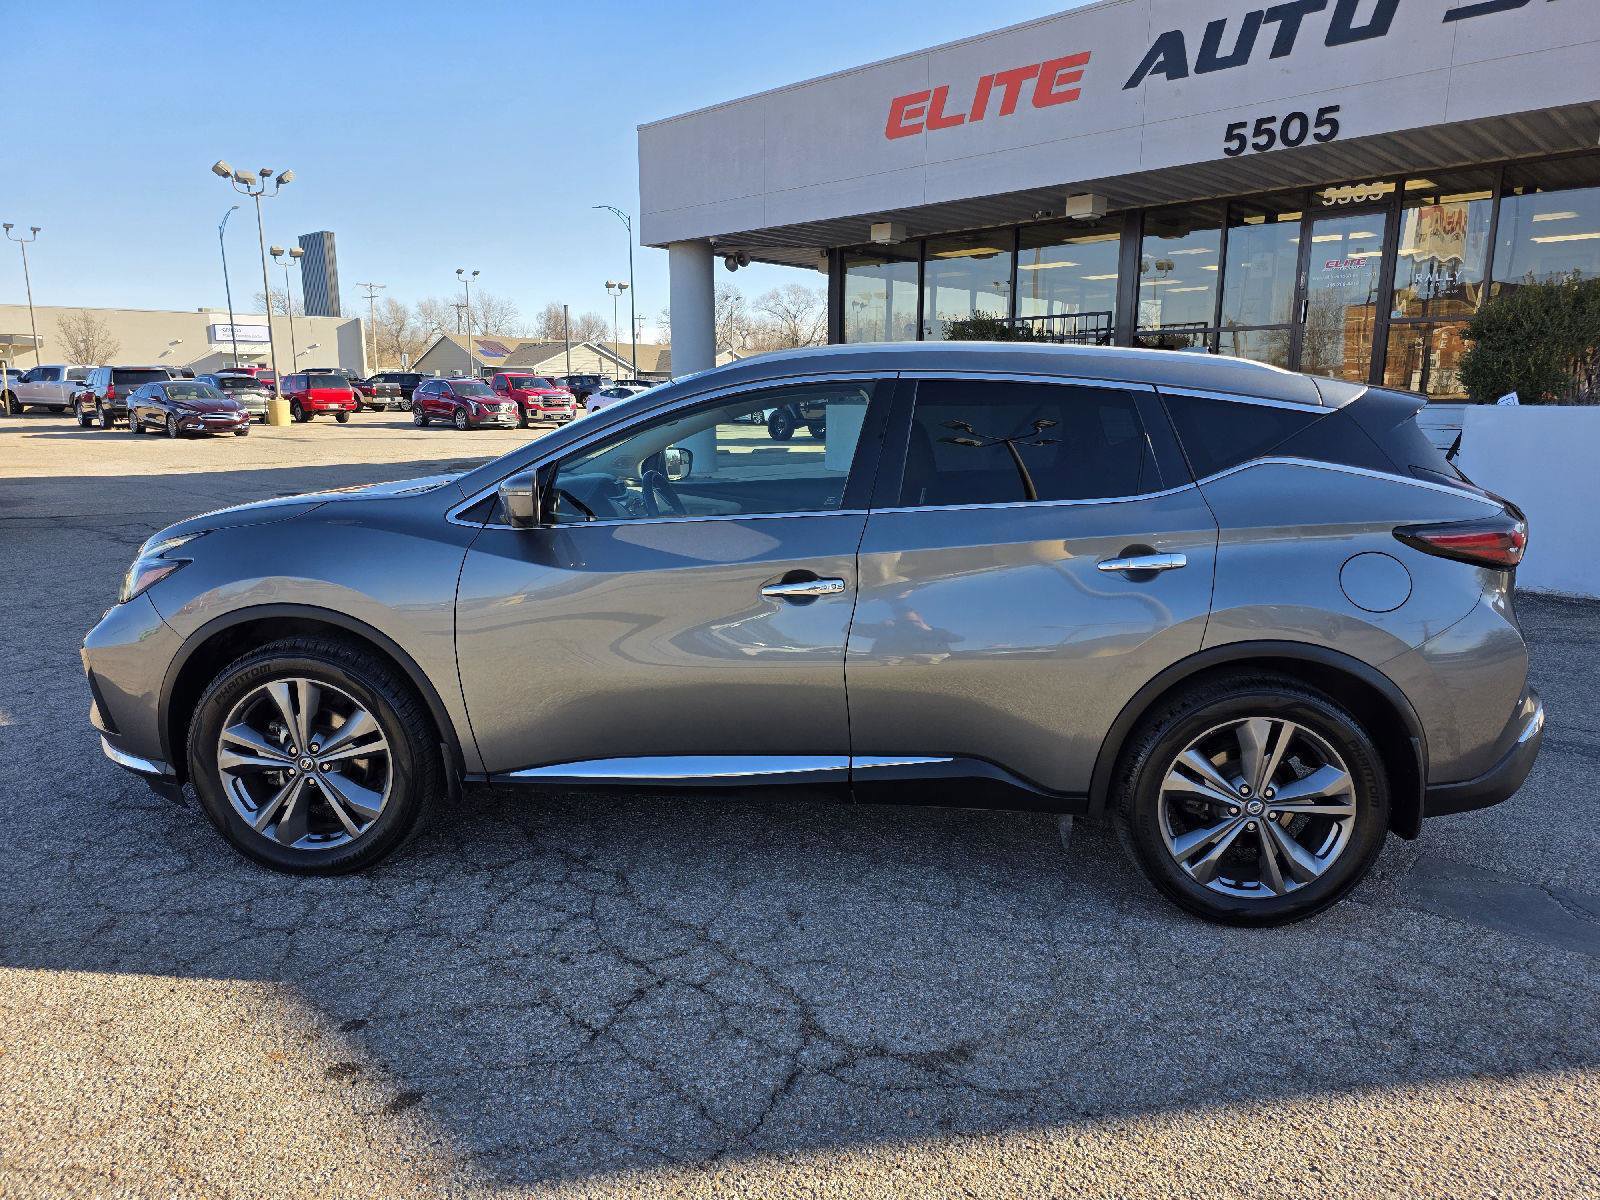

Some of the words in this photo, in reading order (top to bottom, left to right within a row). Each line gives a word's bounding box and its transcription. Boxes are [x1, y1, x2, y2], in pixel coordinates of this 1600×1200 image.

[885, 51, 1092, 140] ELITE
[1122, 0, 1399, 90] AUTO
[1223, 105, 1340, 156] 5505
[1322, 181, 1384, 206] 5505
[1325, 258, 1367, 269] ELITE
[1415, 270, 1463, 283] RALLY
[214, 663, 272, 706] PHANTOM
